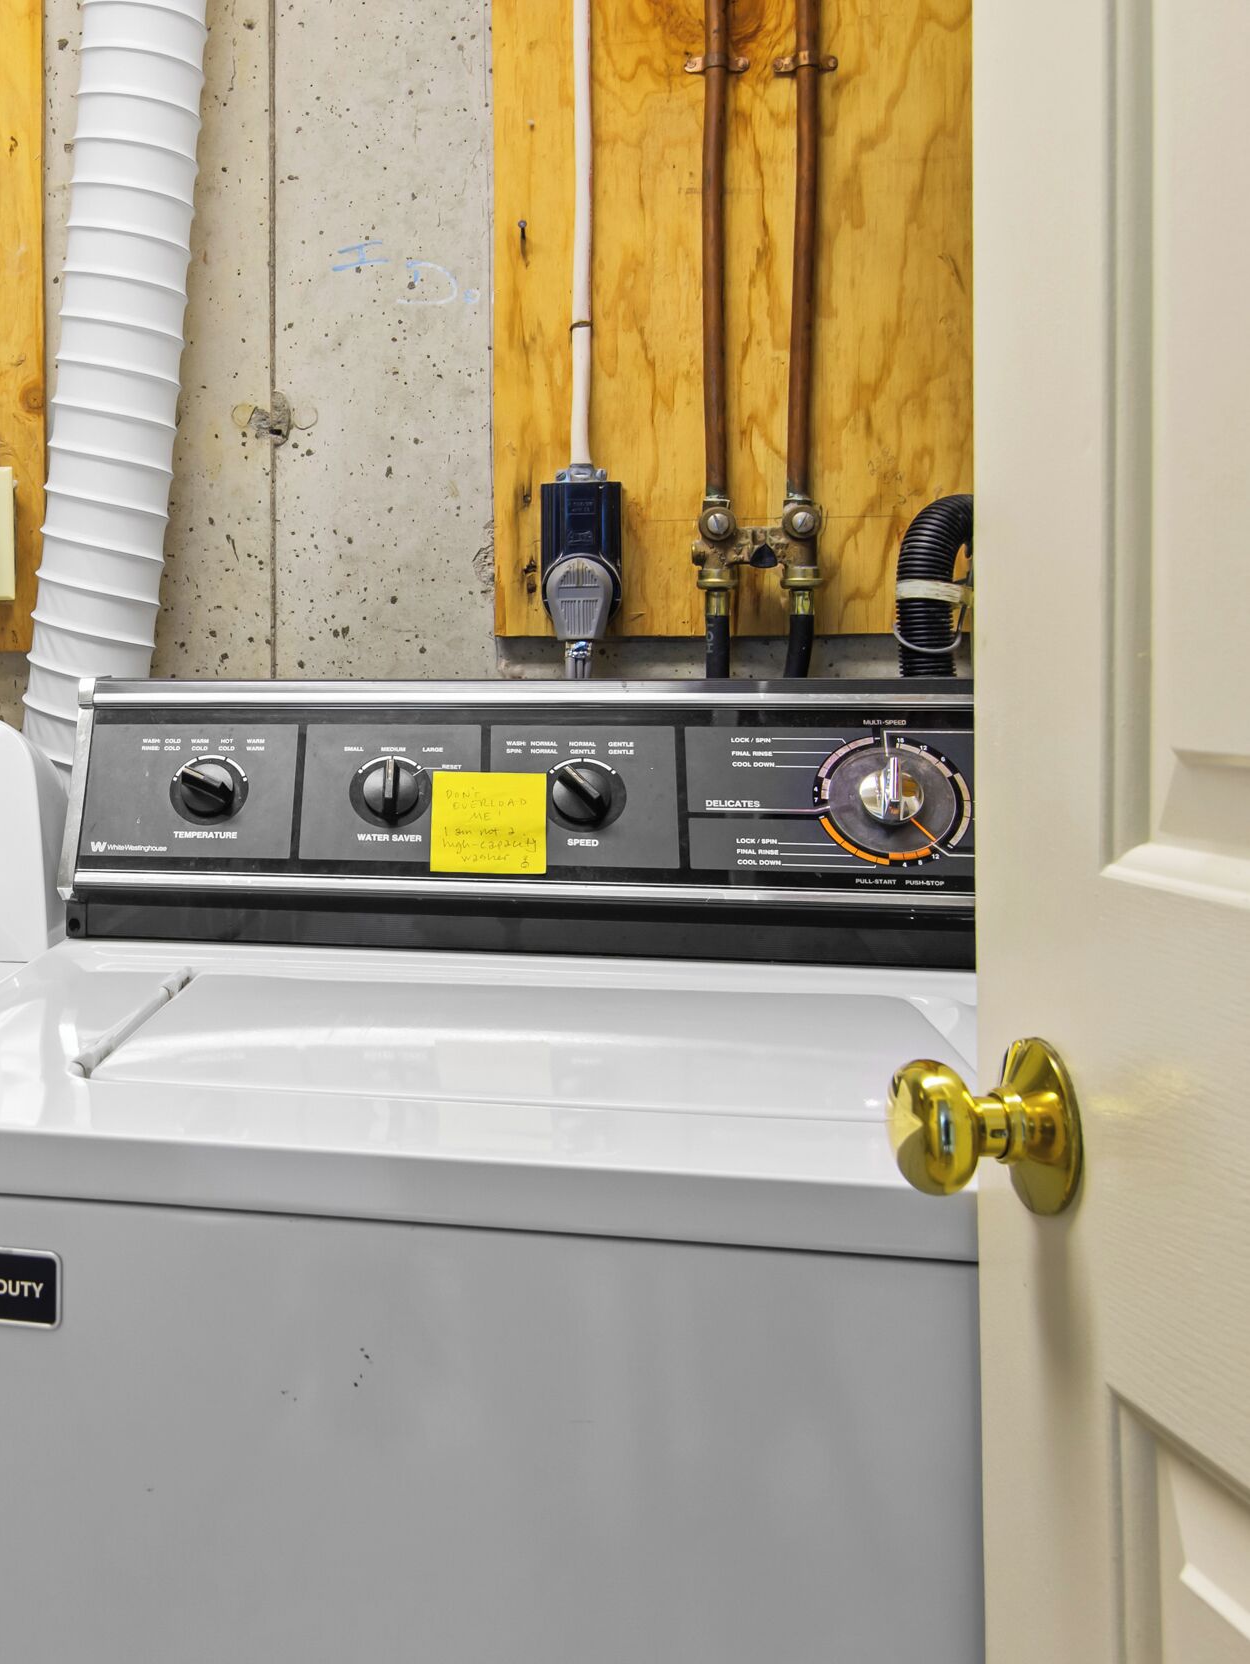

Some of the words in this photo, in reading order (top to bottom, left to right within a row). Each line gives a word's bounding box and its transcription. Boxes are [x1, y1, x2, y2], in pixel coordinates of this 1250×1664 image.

[705, 799, 760, 808] DELICATES
[173, 831, 238, 839] TEMPERATURE
[357, 833, 389, 842] WATER
[392, 834, 422, 842] SAVER
[567, 839, 599, 847] SPEED
